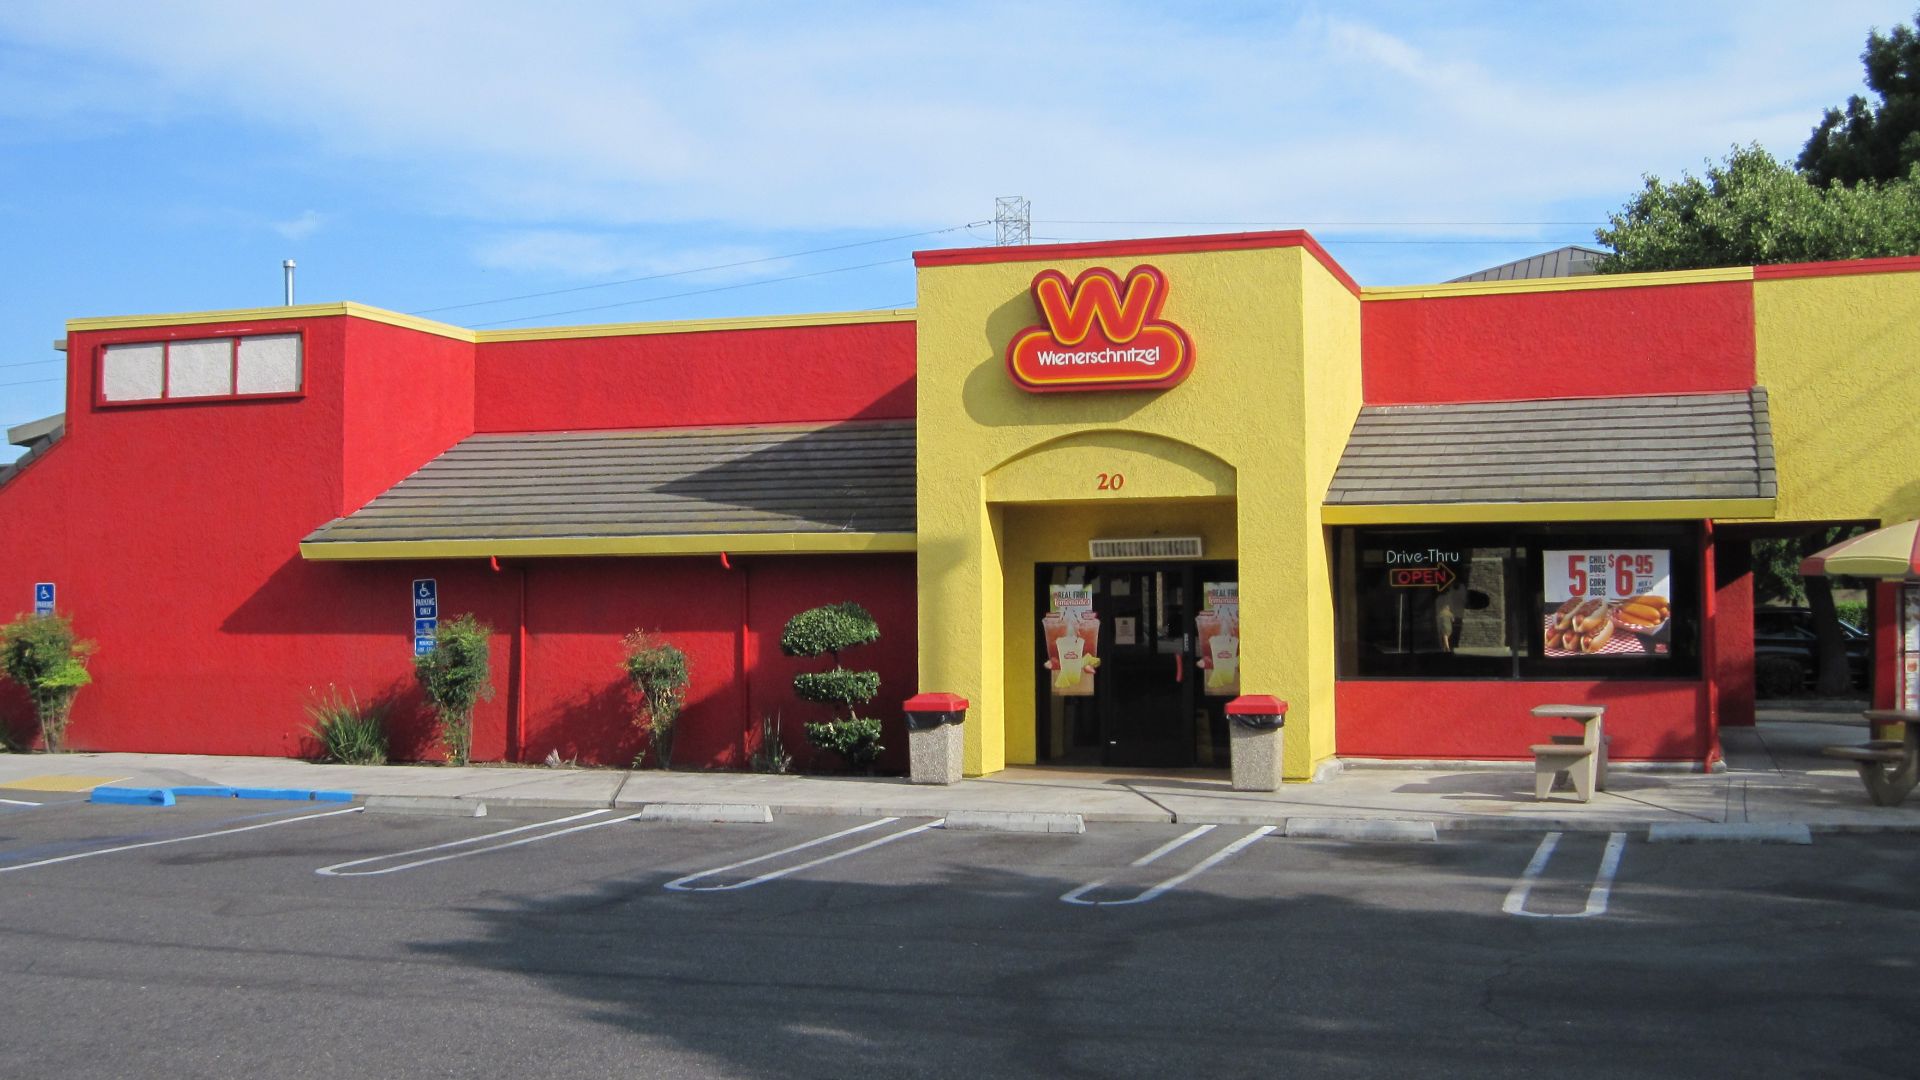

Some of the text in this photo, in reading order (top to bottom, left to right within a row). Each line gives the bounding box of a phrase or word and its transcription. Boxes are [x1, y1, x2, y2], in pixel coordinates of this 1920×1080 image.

[1037, 272, 1156, 346] W
[1037, 346, 1160, 366] Wienerschnitzel
[1096, 473, 1124, 490] 20
[1386, 549, 1459, 564] Drive-Thru
[1589, 555, 1606, 564] CHILI
[1589, 564, 1606, 573] DOGS
[1399, 570, 1446, 585] OPEN
[1568, 555, 1587, 597] 5
[1590, 578, 1607, 587] CORN
[1058, 591, 1088, 599] REAL FRUIT
[1590, 587, 1606, 596] DOGS
[416, 598, 435, 607] PARKING
[420, 607, 431, 615] ONLY
